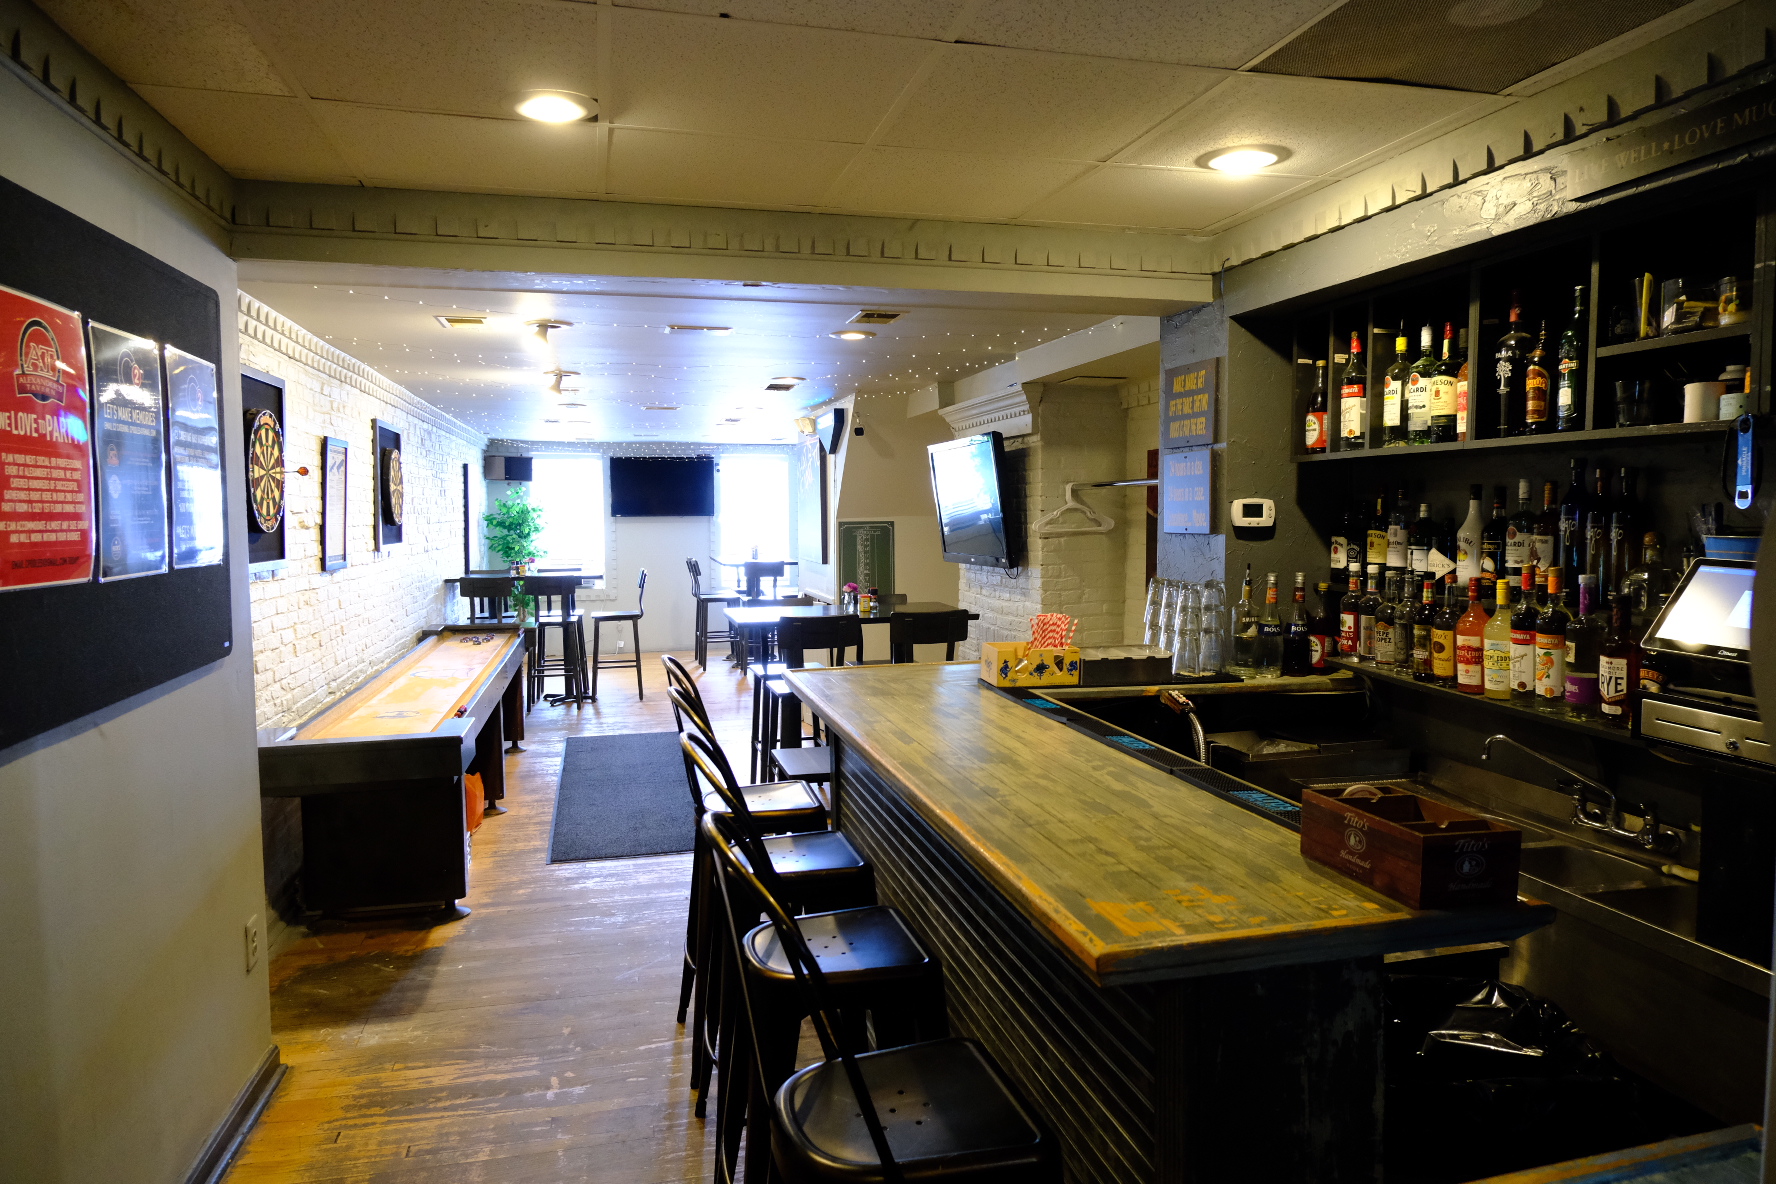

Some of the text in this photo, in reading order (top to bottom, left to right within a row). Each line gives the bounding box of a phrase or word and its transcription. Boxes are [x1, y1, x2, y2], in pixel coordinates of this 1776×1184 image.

[1615, 142, 1662, 168] WELL
[1673, 117, 1727, 150] LOVE
[18, 375, 63, 394] ALEXANDER'S
[26, 384, 57, 397] TAVERN
[1408, 384, 1428, 395] CARDÍ
[11, 410, 38, 437] LOVE
[38, 420, 46, 434] TO
[104, 402, 157, 427] LET'S MAKE MEMORIES
[1, 452, 14, 463] PLAN
[14, 454, 25, 464] YOUR
[26, 455, 36, 465] NEXT
[57, 458, 83, 470] PROFESSIONAL
[5, 465, 19, 476] EVENT
[25, 467, 51, 478] ALEXANDER'S
[1506, 539, 1526, 548] CARDÍ
[1291, 624, 1308, 632] BOLS
[1600, 673, 1625, 697] RYE
[1344, 811, 1370, 832] Tito's
[1455, 837, 1492, 854] Tito's
[1339, 849, 1372, 870] Handmade
[1448, 877, 1494, 890] Handmade
